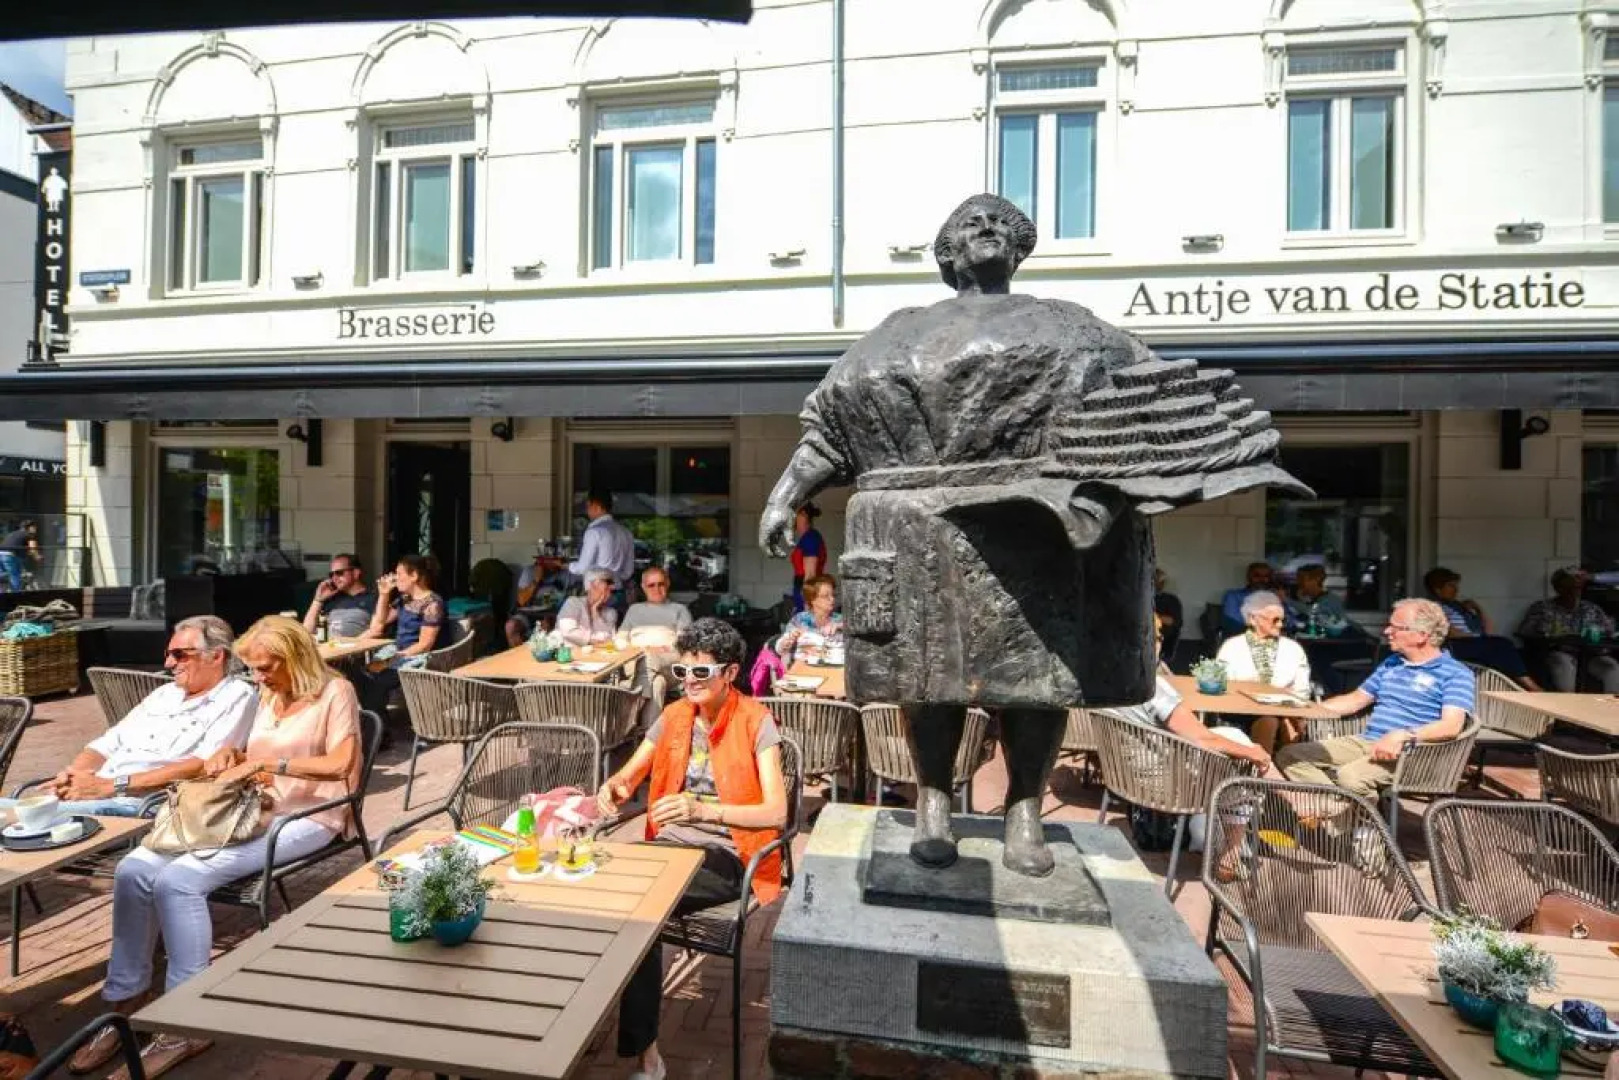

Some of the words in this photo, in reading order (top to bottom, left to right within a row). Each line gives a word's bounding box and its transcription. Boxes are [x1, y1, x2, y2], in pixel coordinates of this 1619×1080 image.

[46, 218, 63, 330] HOTEL
[1123, 280, 1251, 322] Antje
[1264, 285, 1351, 313] van
[1365, 273, 1420, 311] de
[1438, 272, 1585, 310] Statie
[337, 304, 495, 339] Brasserie
[20, 461, 46, 473] ALL
